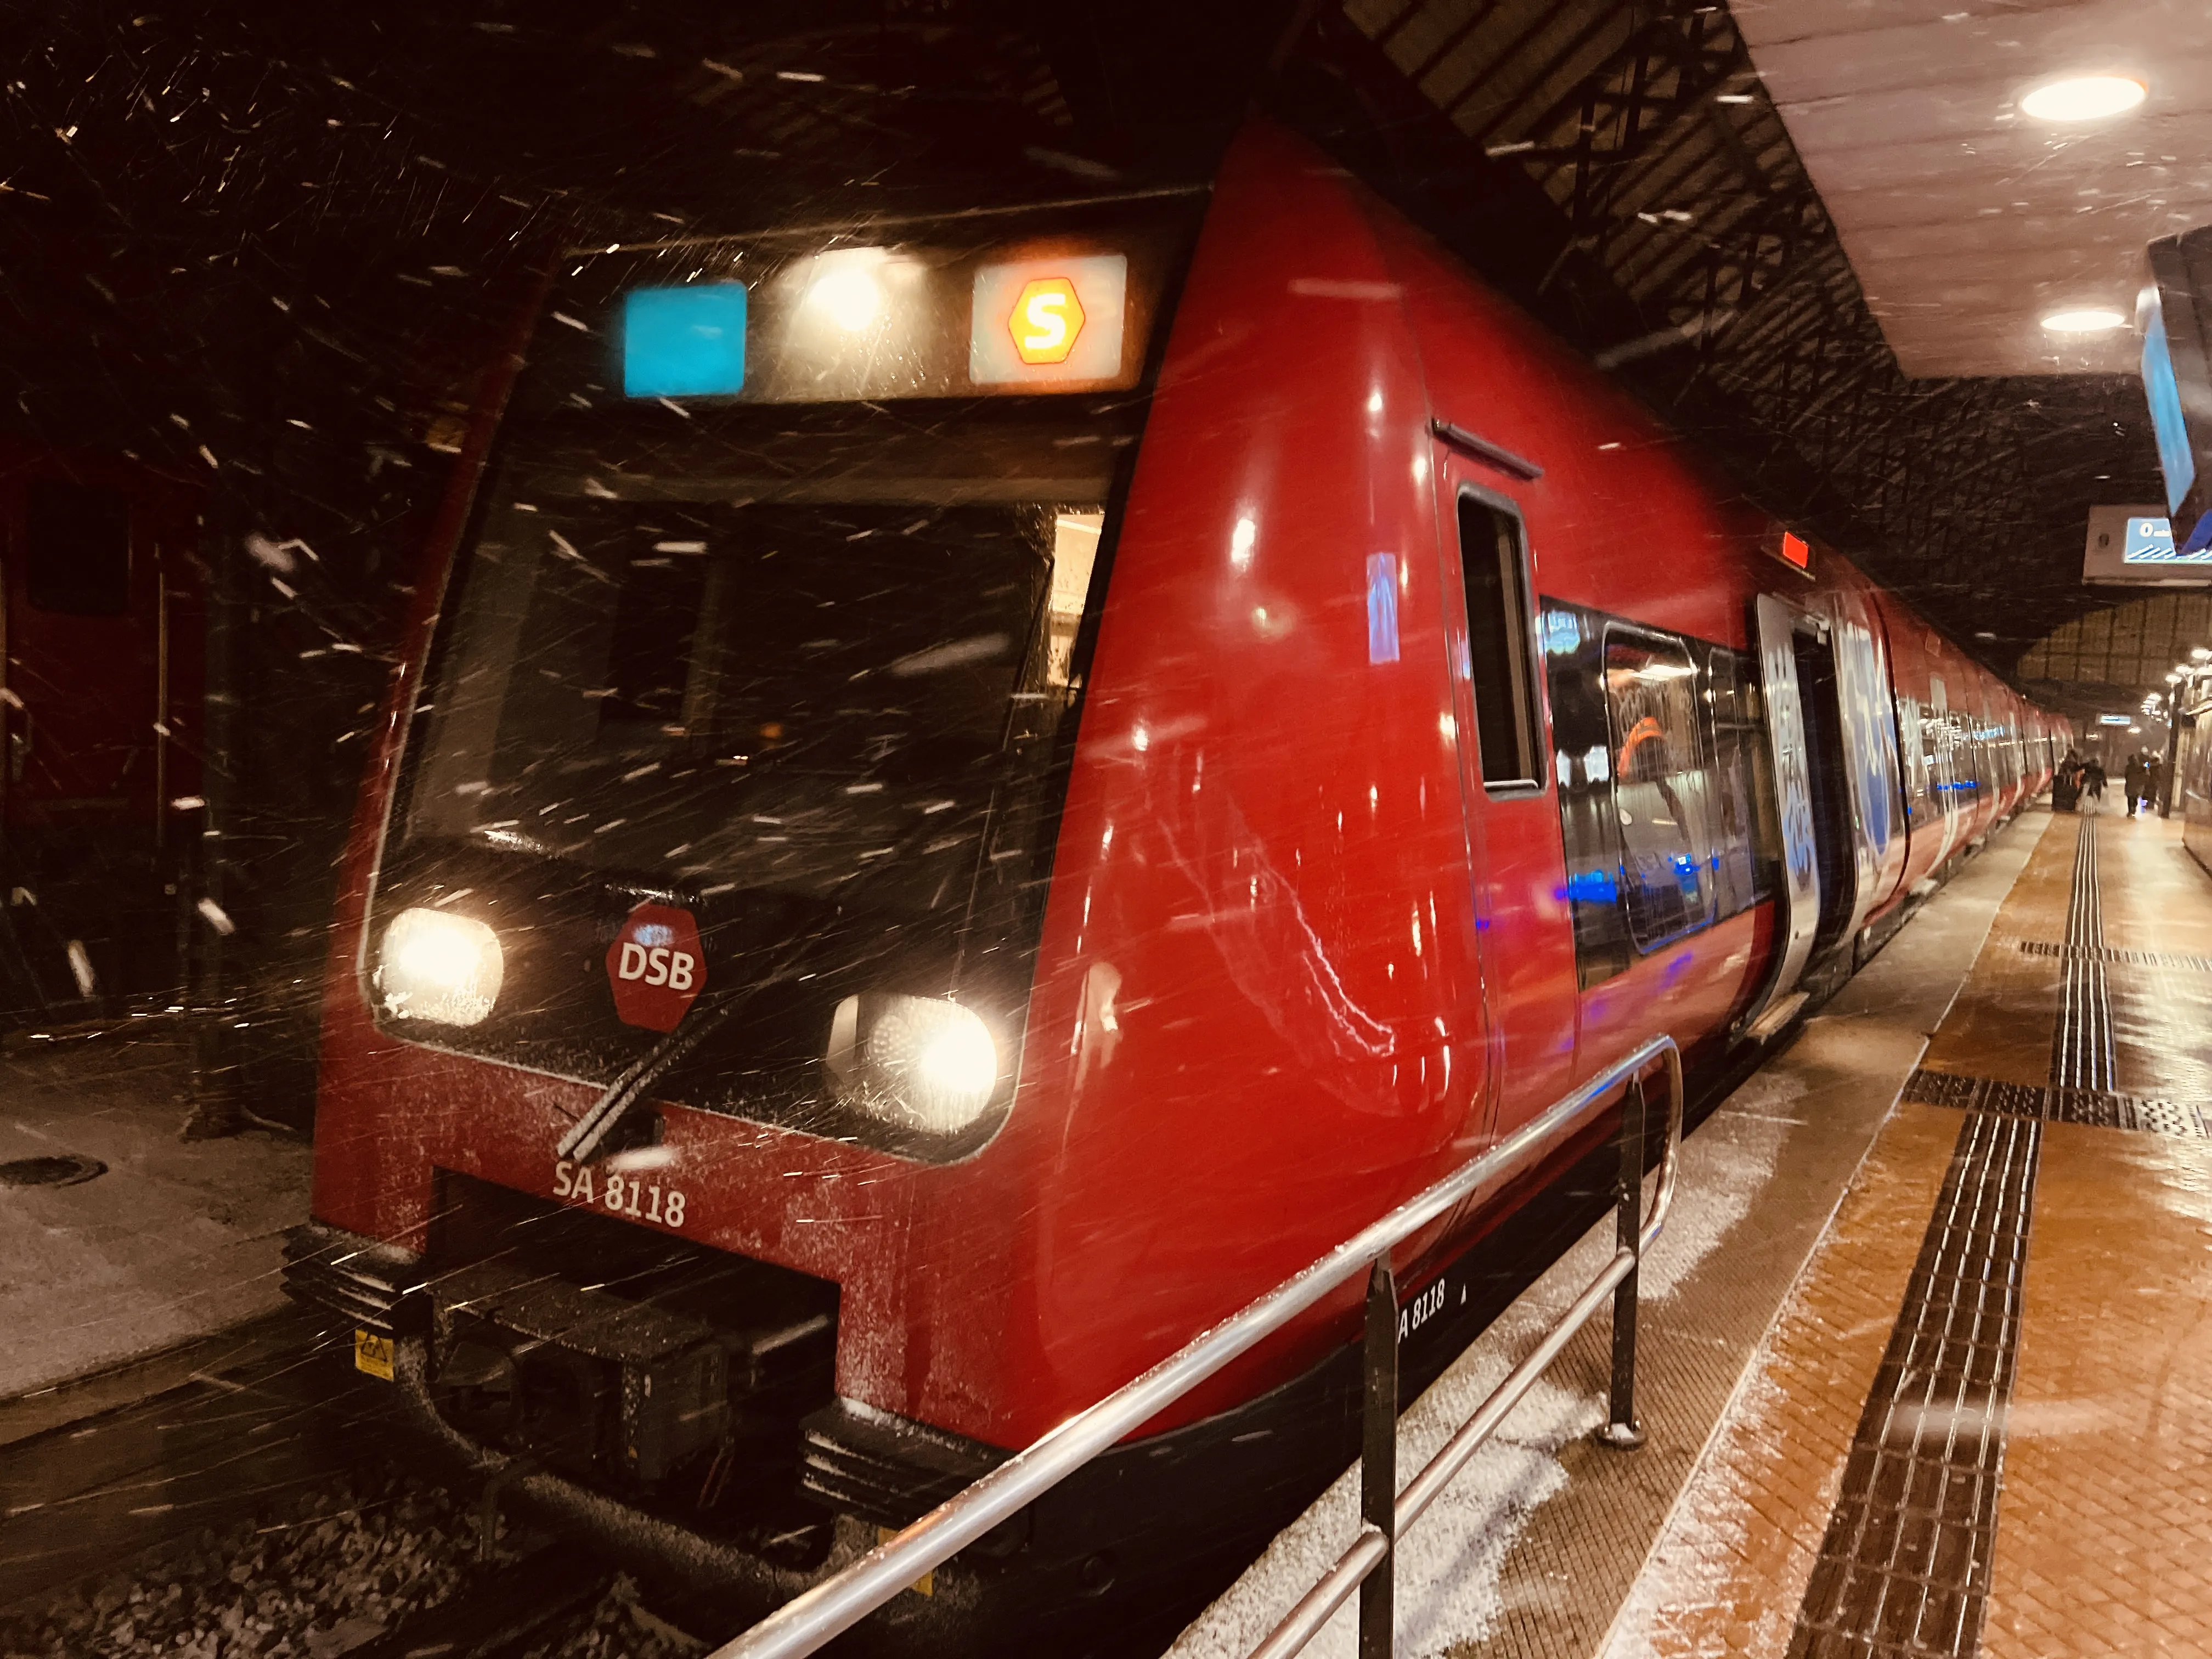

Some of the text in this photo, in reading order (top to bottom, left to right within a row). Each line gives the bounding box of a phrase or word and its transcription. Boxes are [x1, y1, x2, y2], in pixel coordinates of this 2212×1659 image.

[1024, 292, 1066, 349] S
[618, 942, 694, 990] DSB
[552, 1161, 686, 1228] SA 8118
[1398, 1278, 1445, 1344] A 8118
